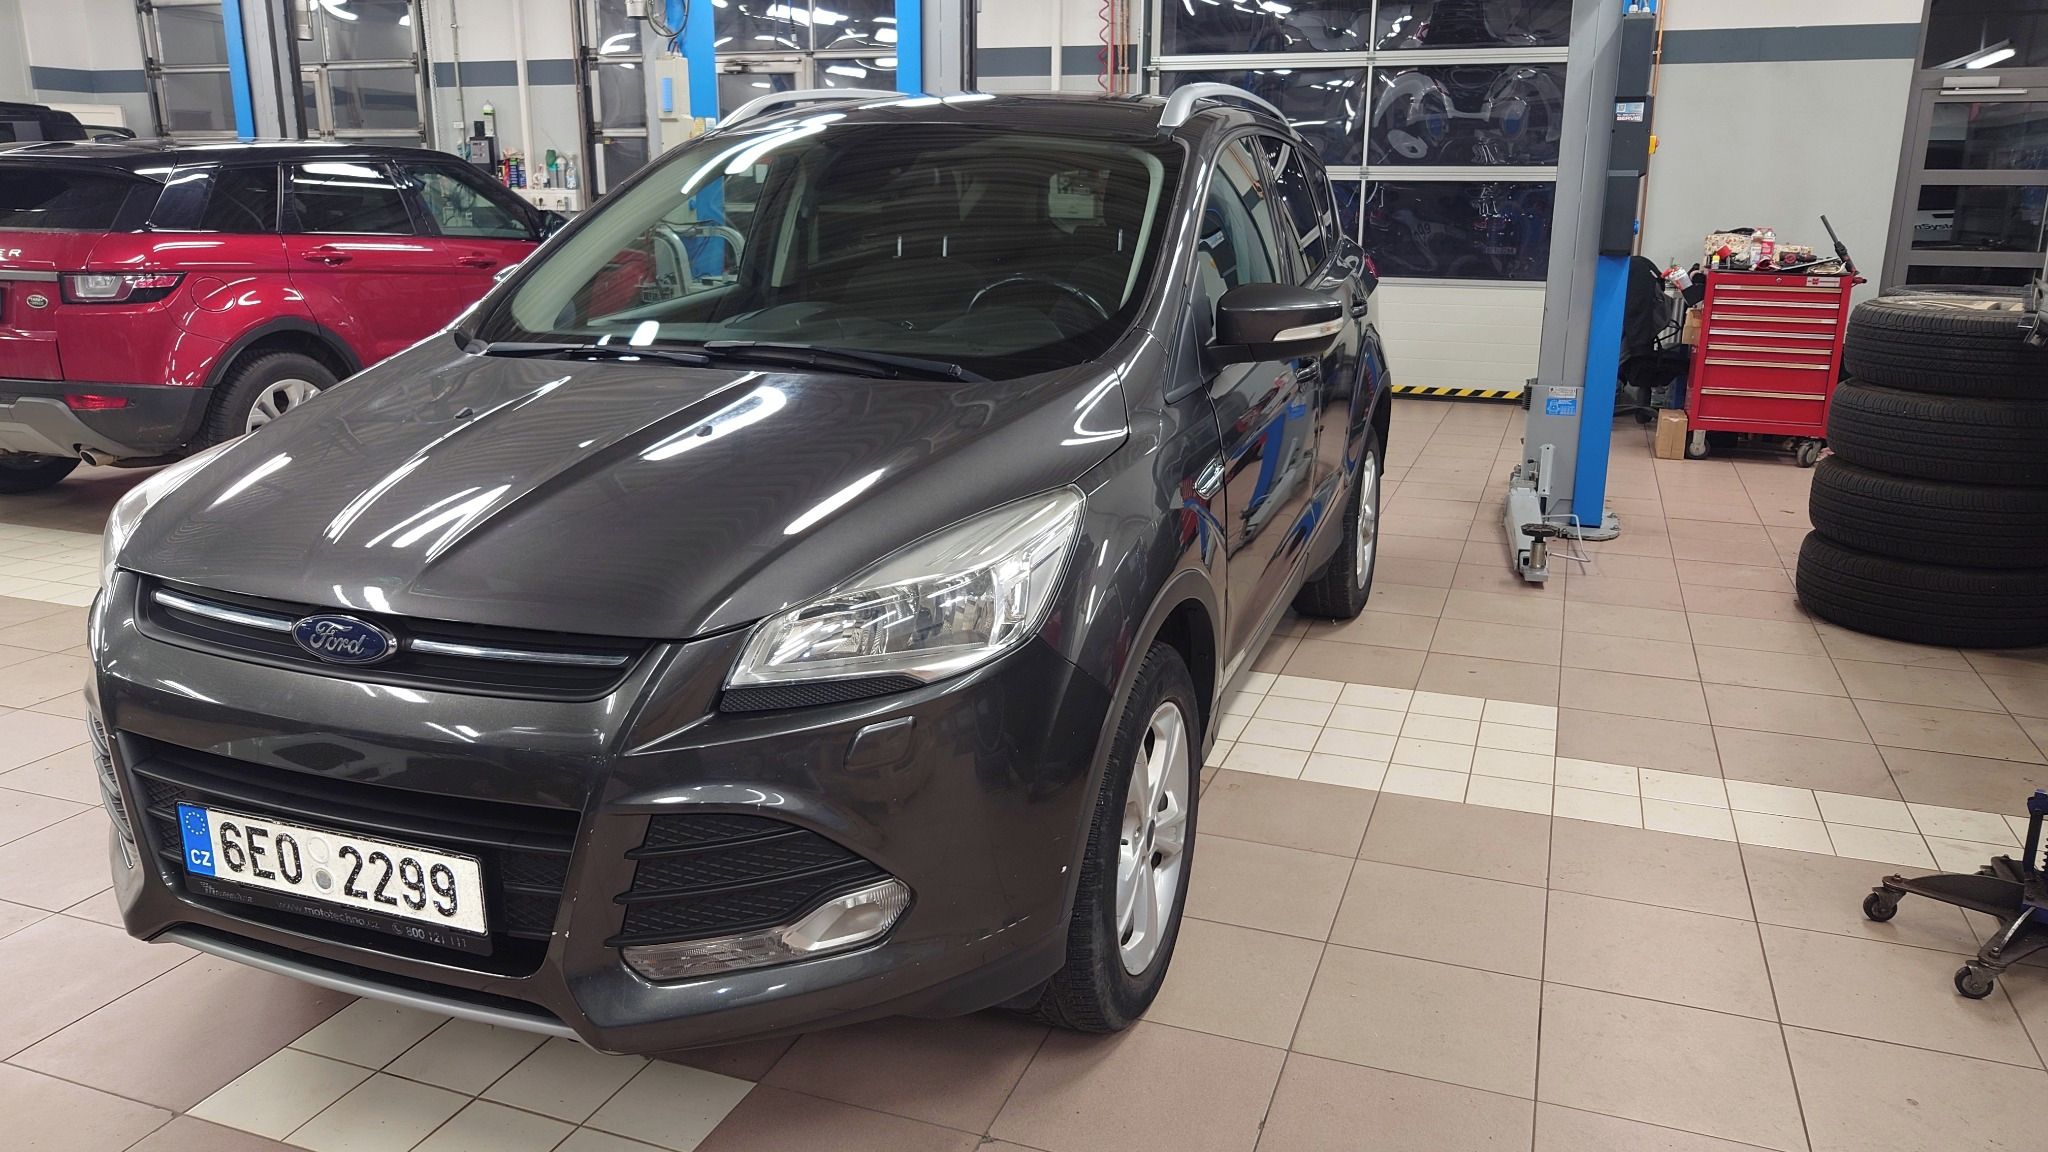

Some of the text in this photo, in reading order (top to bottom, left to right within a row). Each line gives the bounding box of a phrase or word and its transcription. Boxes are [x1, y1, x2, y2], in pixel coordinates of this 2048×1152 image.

[309, 620, 368, 655] Ford
[190, 849, 212, 867] CZ
[219, 821, 458, 916] 6E0 2299
[405, 926, 426, 940] 800
